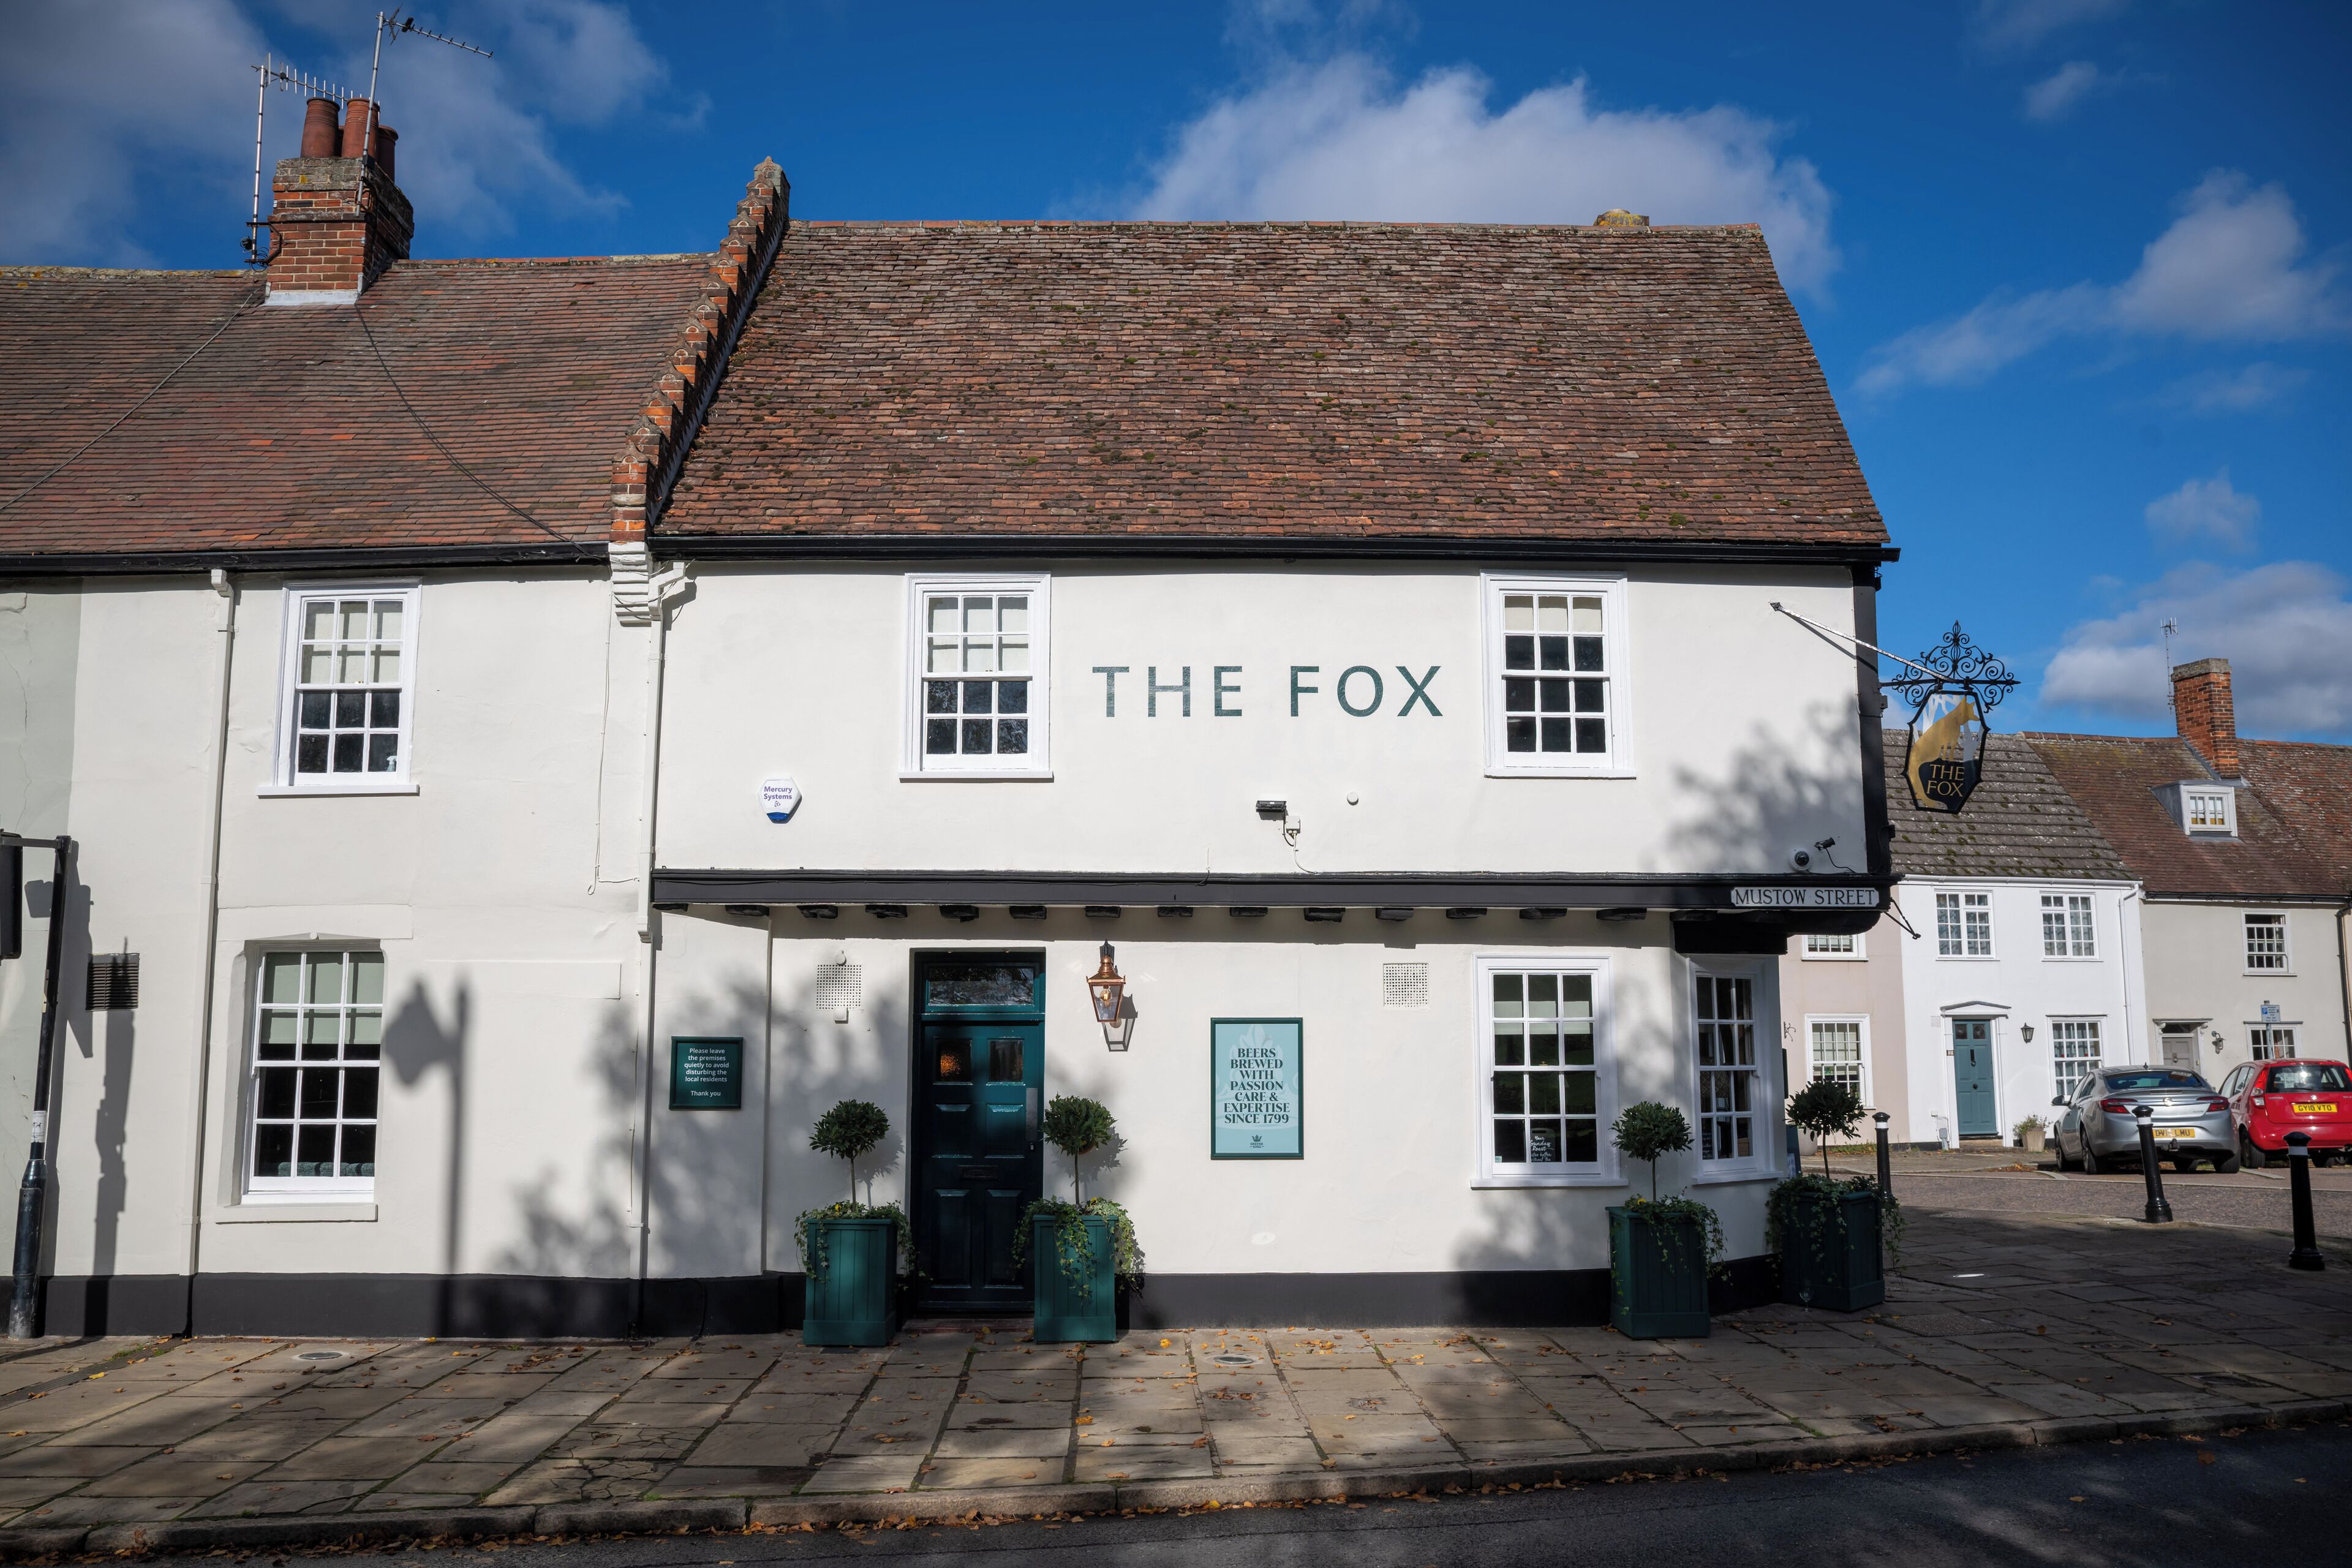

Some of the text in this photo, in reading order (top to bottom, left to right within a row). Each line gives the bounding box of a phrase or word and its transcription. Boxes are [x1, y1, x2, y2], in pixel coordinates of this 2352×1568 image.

[1092, 665, 1443, 717] THE FOX
[1930, 764, 1965, 781] THE
[1926, 780, 1964, 797] FOX
[1735, 889, 1874, 905] MUSTOW STREET
[1237, 1048, 1276, 1058] BEERS
[1231, 1059, 1283, 1069] BREWED
[1240, 1070, 1274, 1079] WITH
[1231, 1080, 1283, 1090] PASSION
[1235, 1091, 1278, 1101] CARE &
[1224, 1102, 1290, 1112] EXPERTISE
[1224, 1114, 1289, 1123] SINCE 1799
